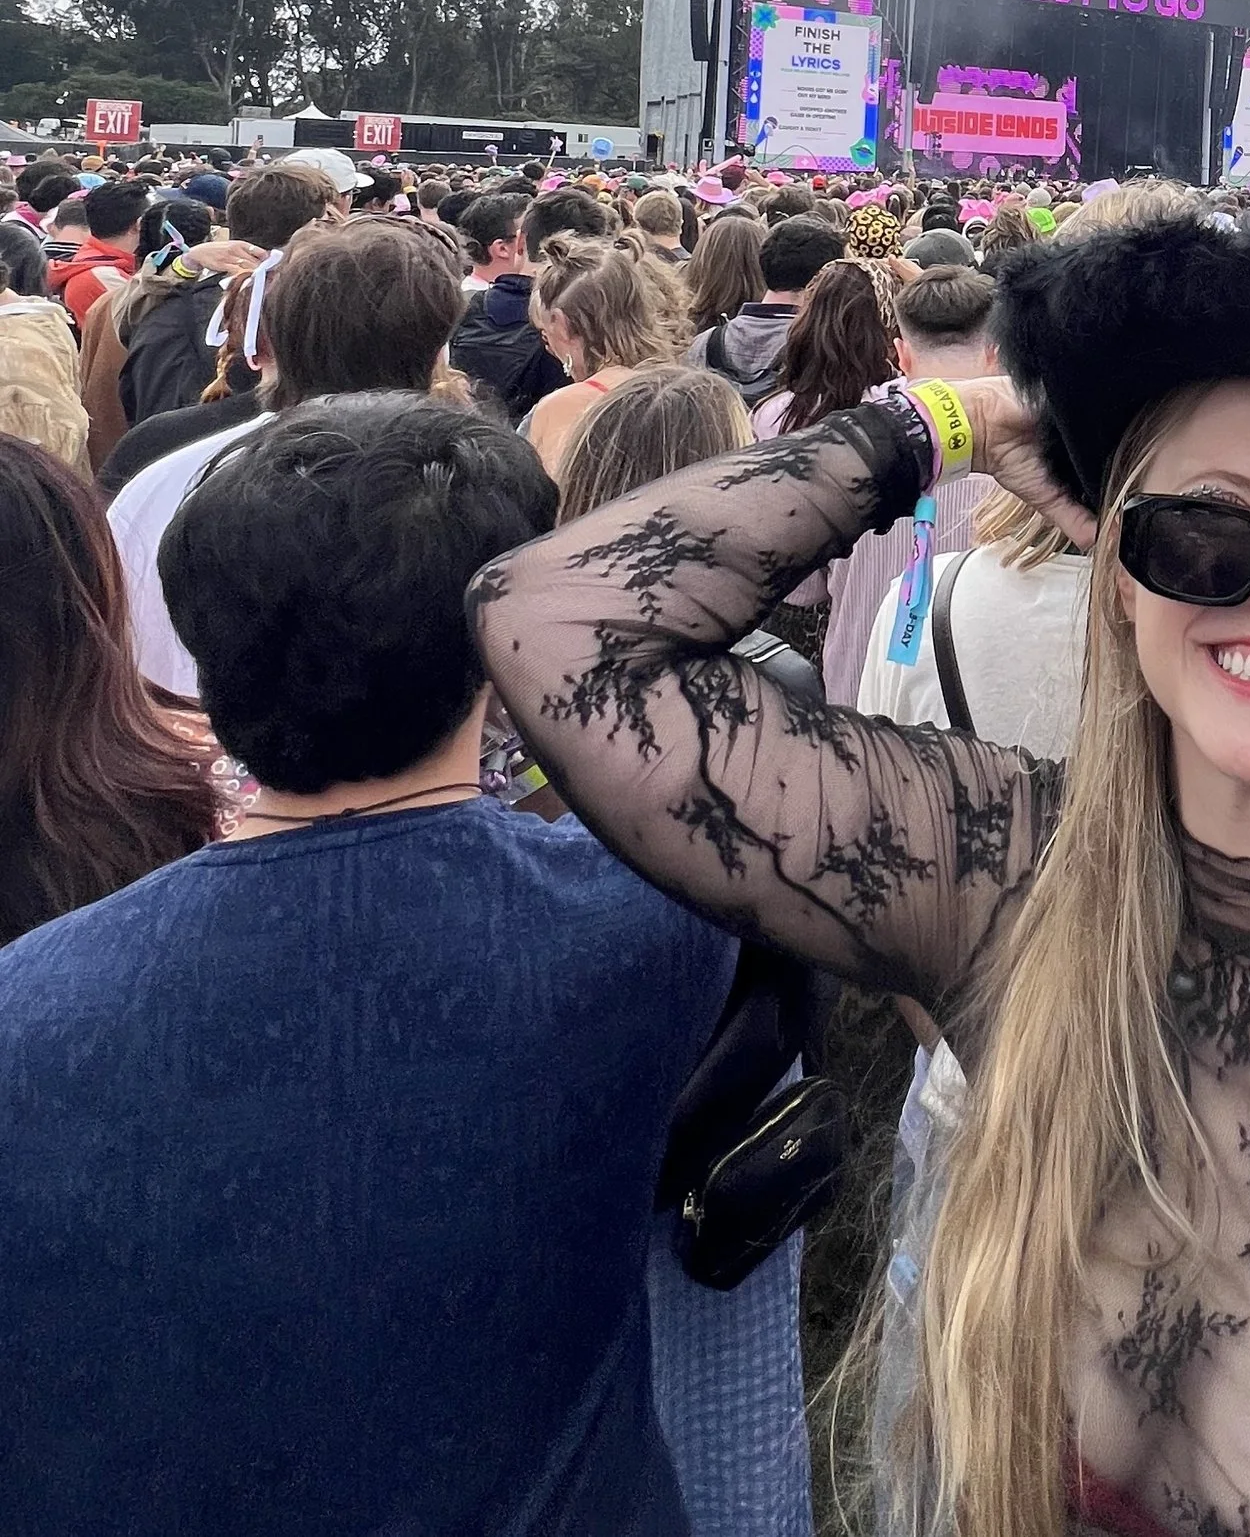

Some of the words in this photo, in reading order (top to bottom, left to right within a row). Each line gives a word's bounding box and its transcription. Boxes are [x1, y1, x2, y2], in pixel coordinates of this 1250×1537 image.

[794, 26, 841, 41] FINISH
[803, 42, 831, 54] THE
[791, 55, 841, 70] LYRICS
[94, 111, 133, 134] EXIT
[363, 123, 395, 146] EXIT
